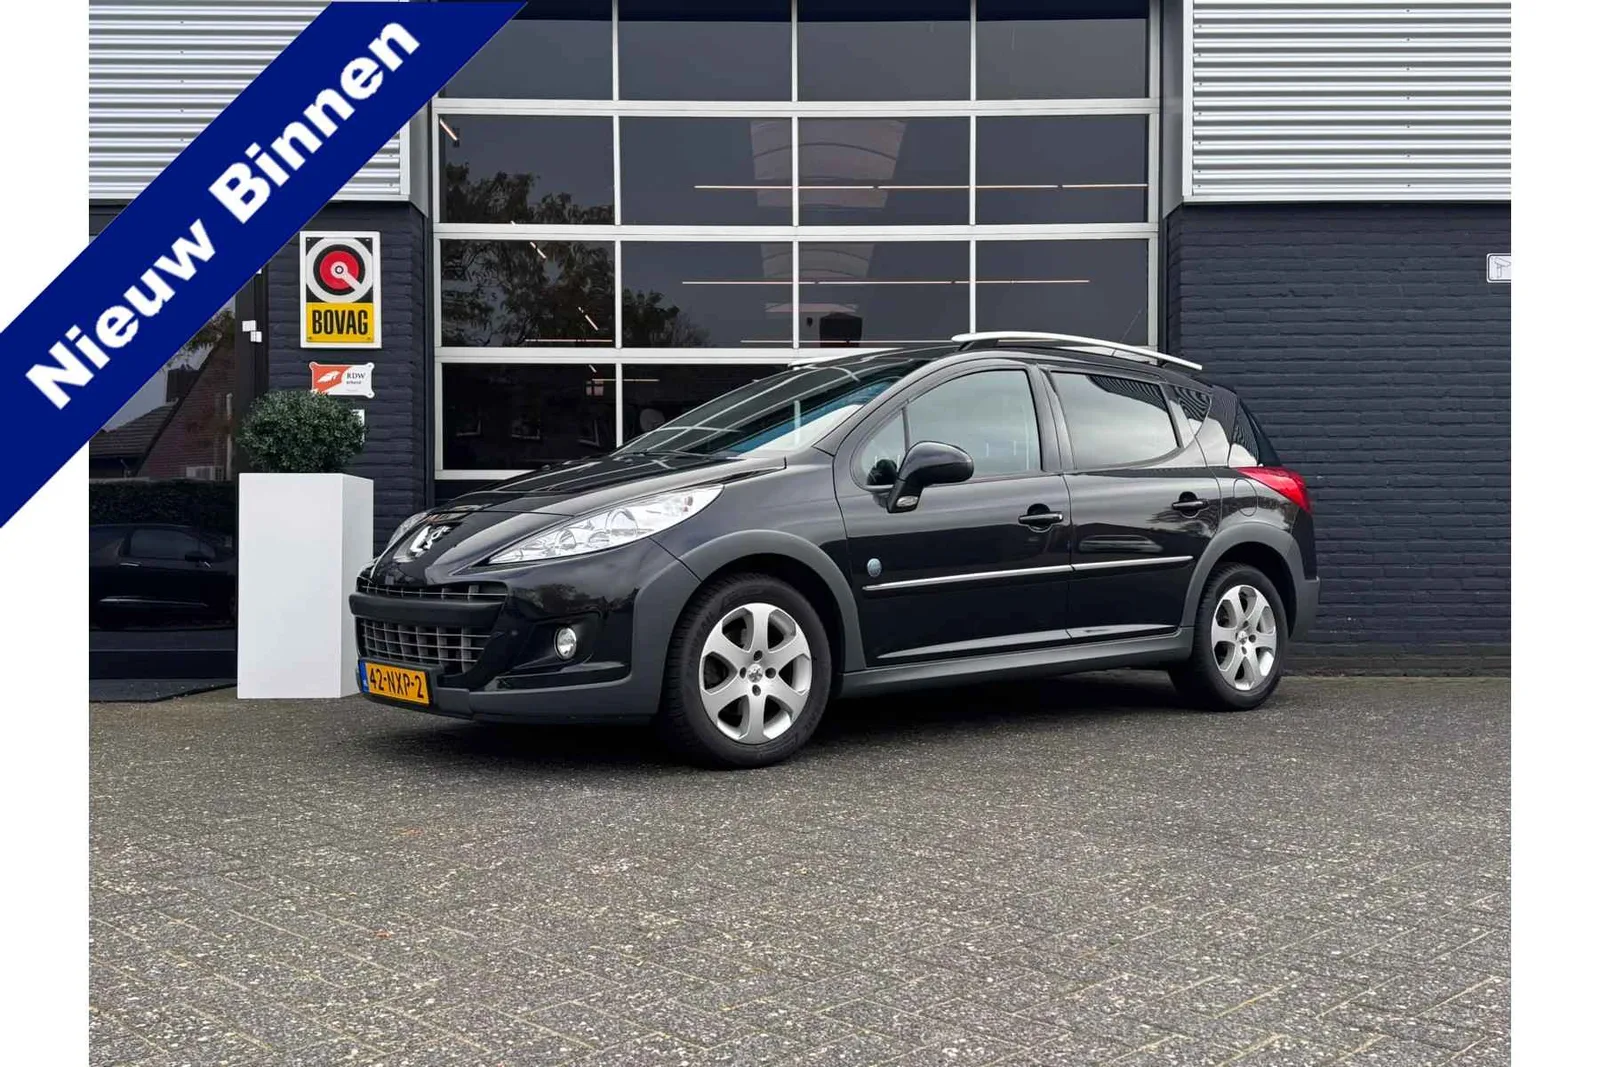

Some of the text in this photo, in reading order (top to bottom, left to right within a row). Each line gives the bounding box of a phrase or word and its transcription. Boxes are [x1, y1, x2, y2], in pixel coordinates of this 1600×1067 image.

[312, 309, 368, 335] BOVAG
[346, 372, 365, 380] RDW
[370, 668, 424, 698] 42-NXP-2
